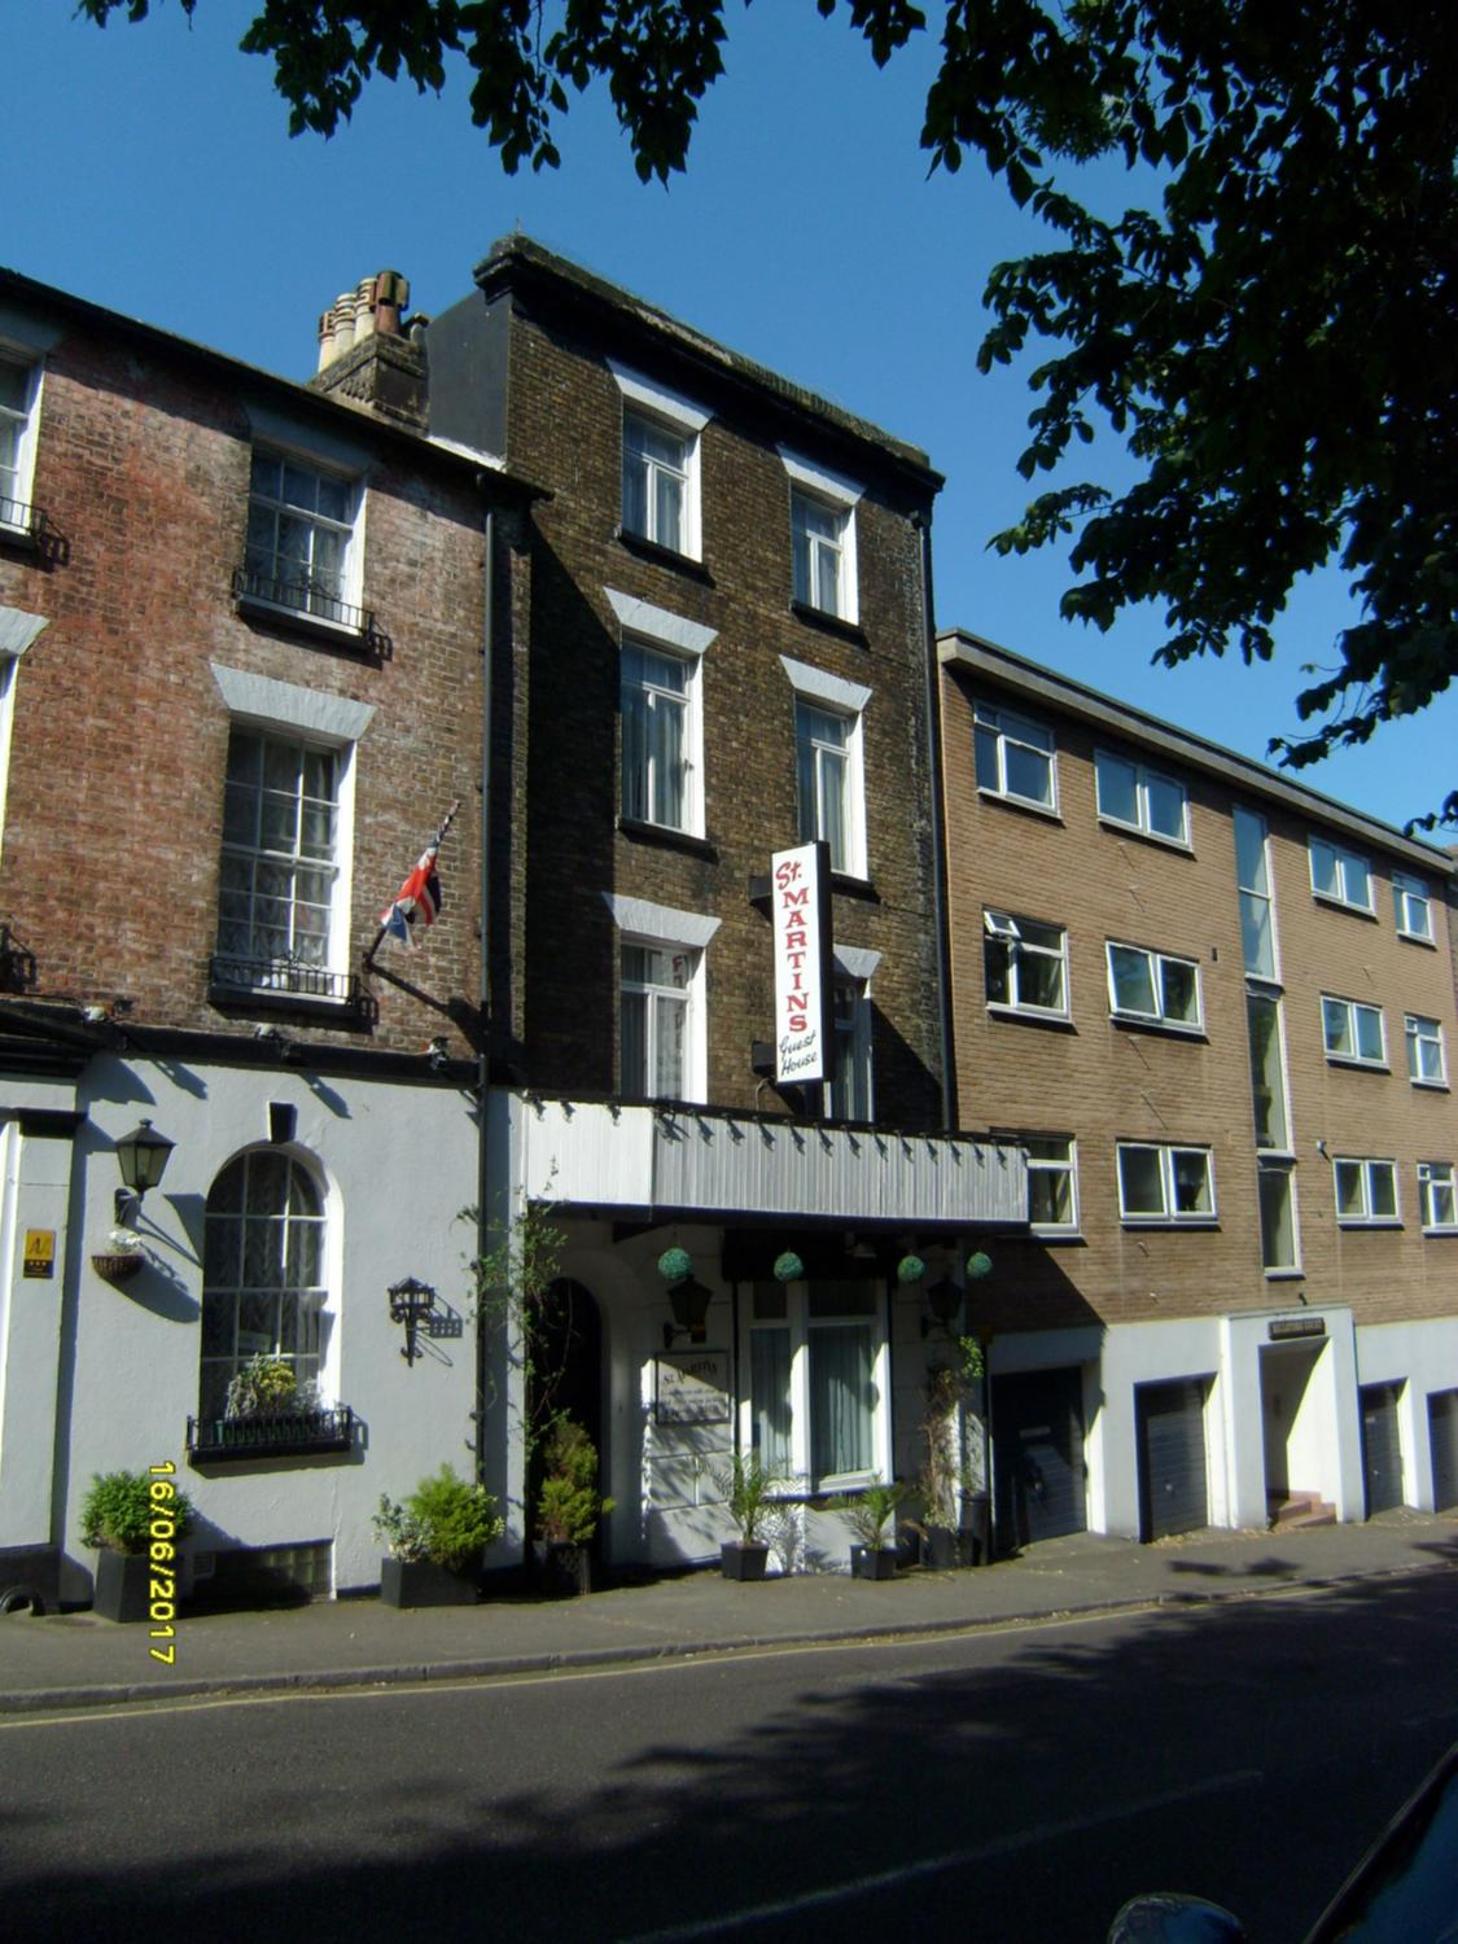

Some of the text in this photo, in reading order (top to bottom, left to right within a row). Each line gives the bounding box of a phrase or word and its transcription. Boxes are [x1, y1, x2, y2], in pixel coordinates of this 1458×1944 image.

[782, 886, 810, 1033] MARTINS
[779, 1029, 816, 1062] Guest
[780, 1051, 818, 1077] House
